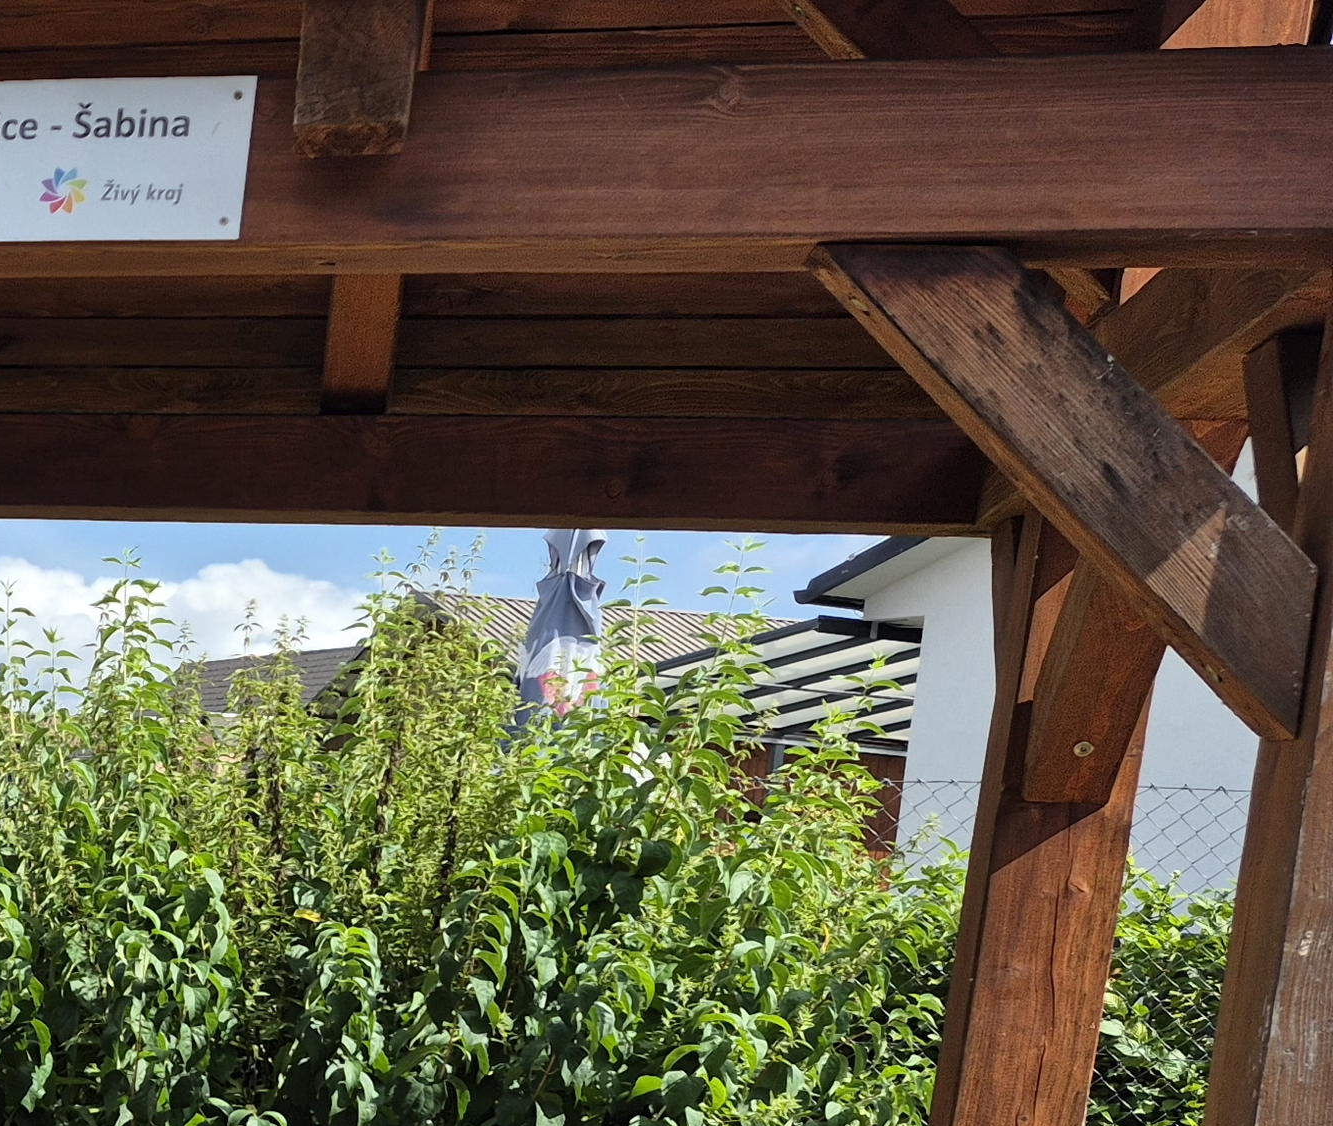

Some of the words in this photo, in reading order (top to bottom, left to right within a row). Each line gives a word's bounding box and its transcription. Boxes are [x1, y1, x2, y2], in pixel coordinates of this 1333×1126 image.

[71, 101, 191, 140] Šabina
[99, 179, 141, 206] Živý
[145, 183, 184, 206] kraj
